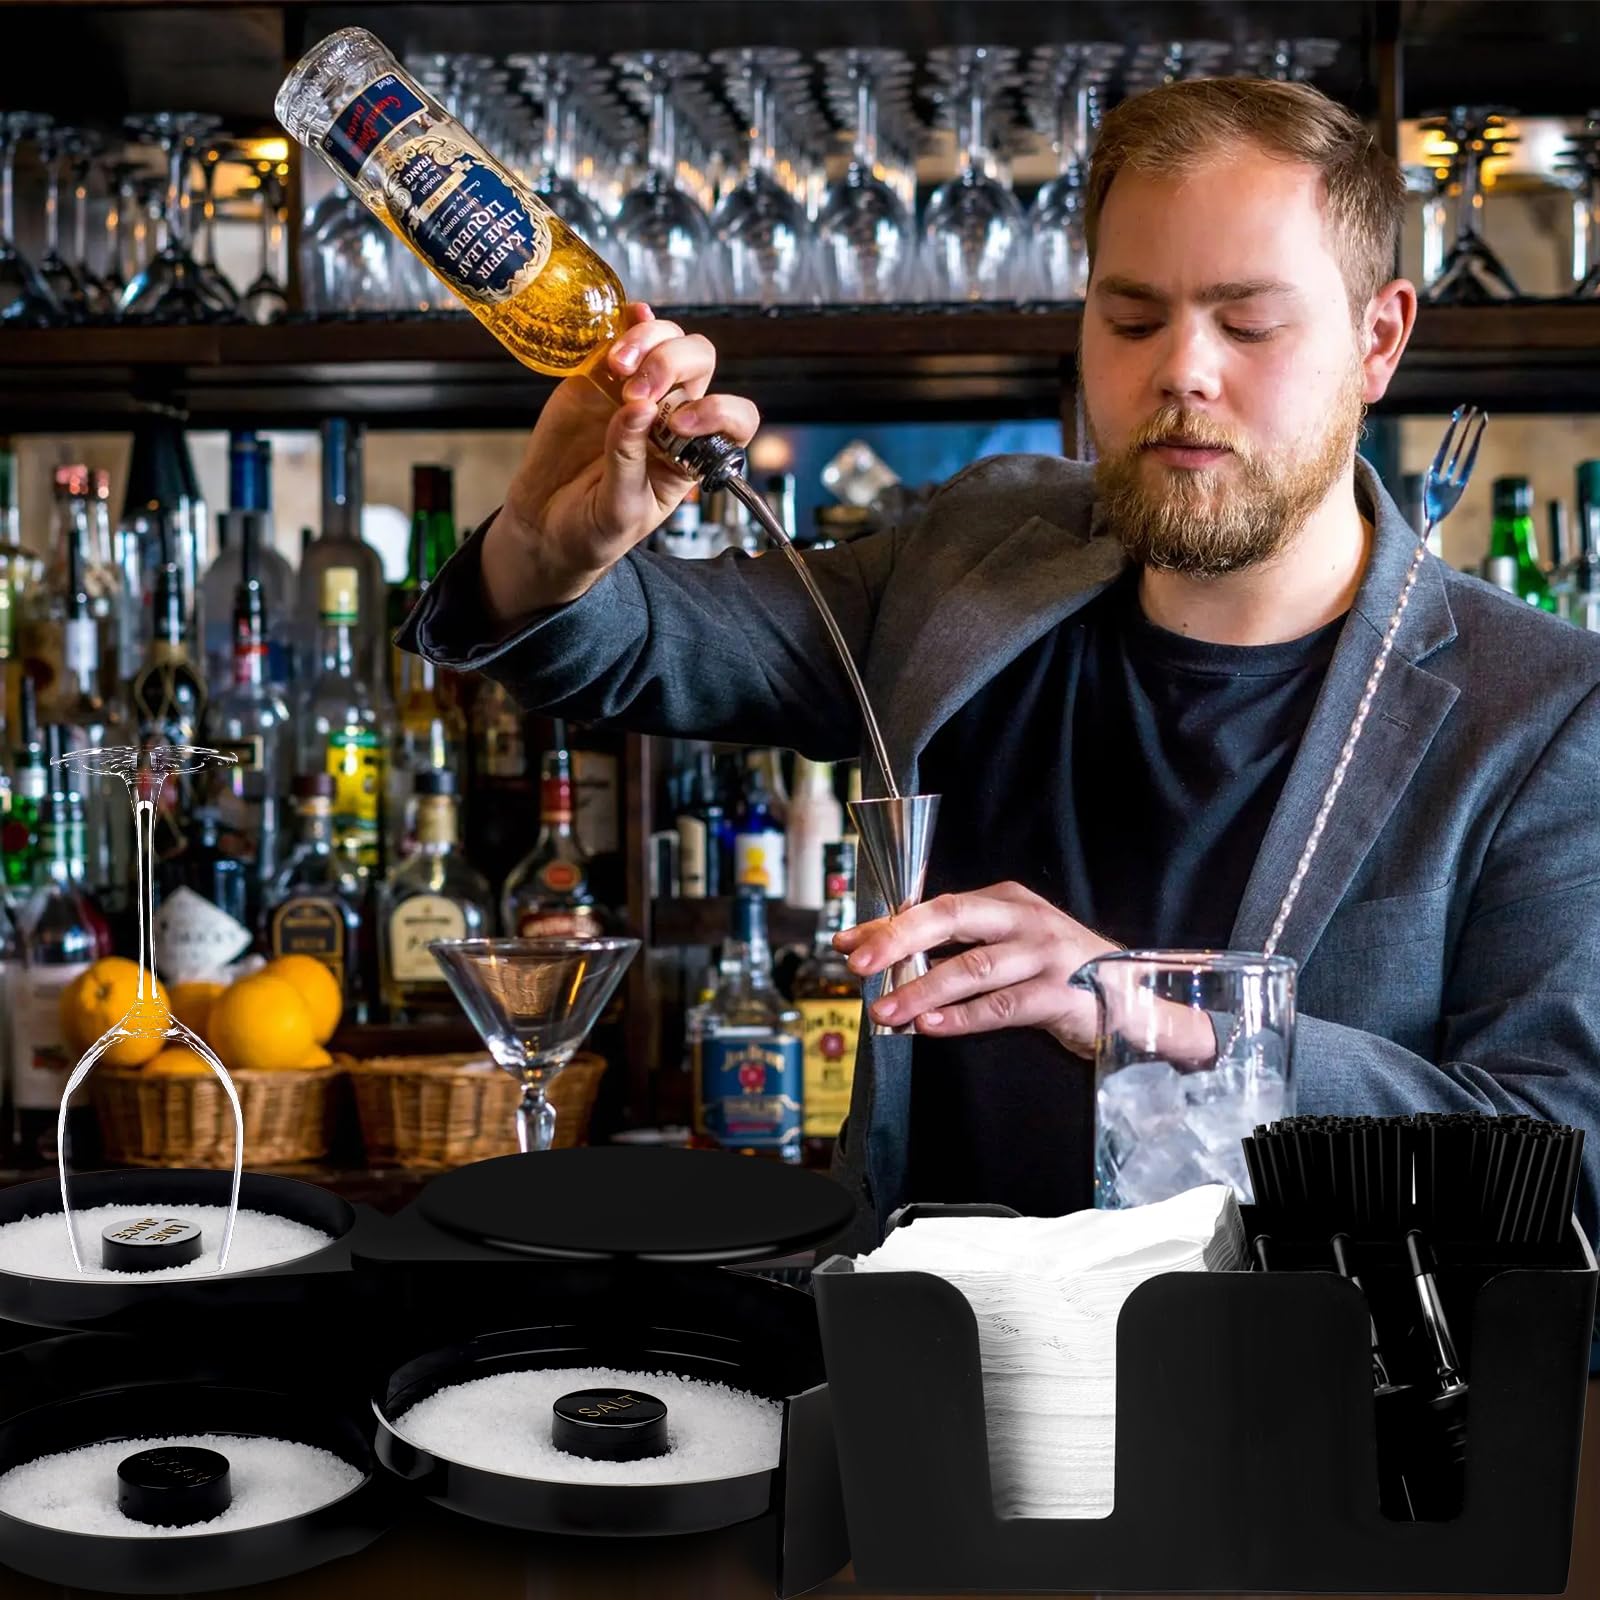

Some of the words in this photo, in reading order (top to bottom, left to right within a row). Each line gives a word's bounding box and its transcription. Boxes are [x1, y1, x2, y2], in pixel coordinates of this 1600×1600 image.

[403, 155, 432, 185] FRANCE
[419, 172, 429, 182] de
[419, 173, 442, 195] Produit
[456, 196, 480, 219] LIMITED
[440, 215, 459, 238] EDITION
[444, 199, 505, 261] LIQUEUR
[487, 209, 524, 243] LIME
[458, 239, 489, 278] LEAF
[476, 230, 527, 279] KAFFIR
[145, 1224, 190, 1242] LIME
[578, 1394, 641, 1417] SALT
